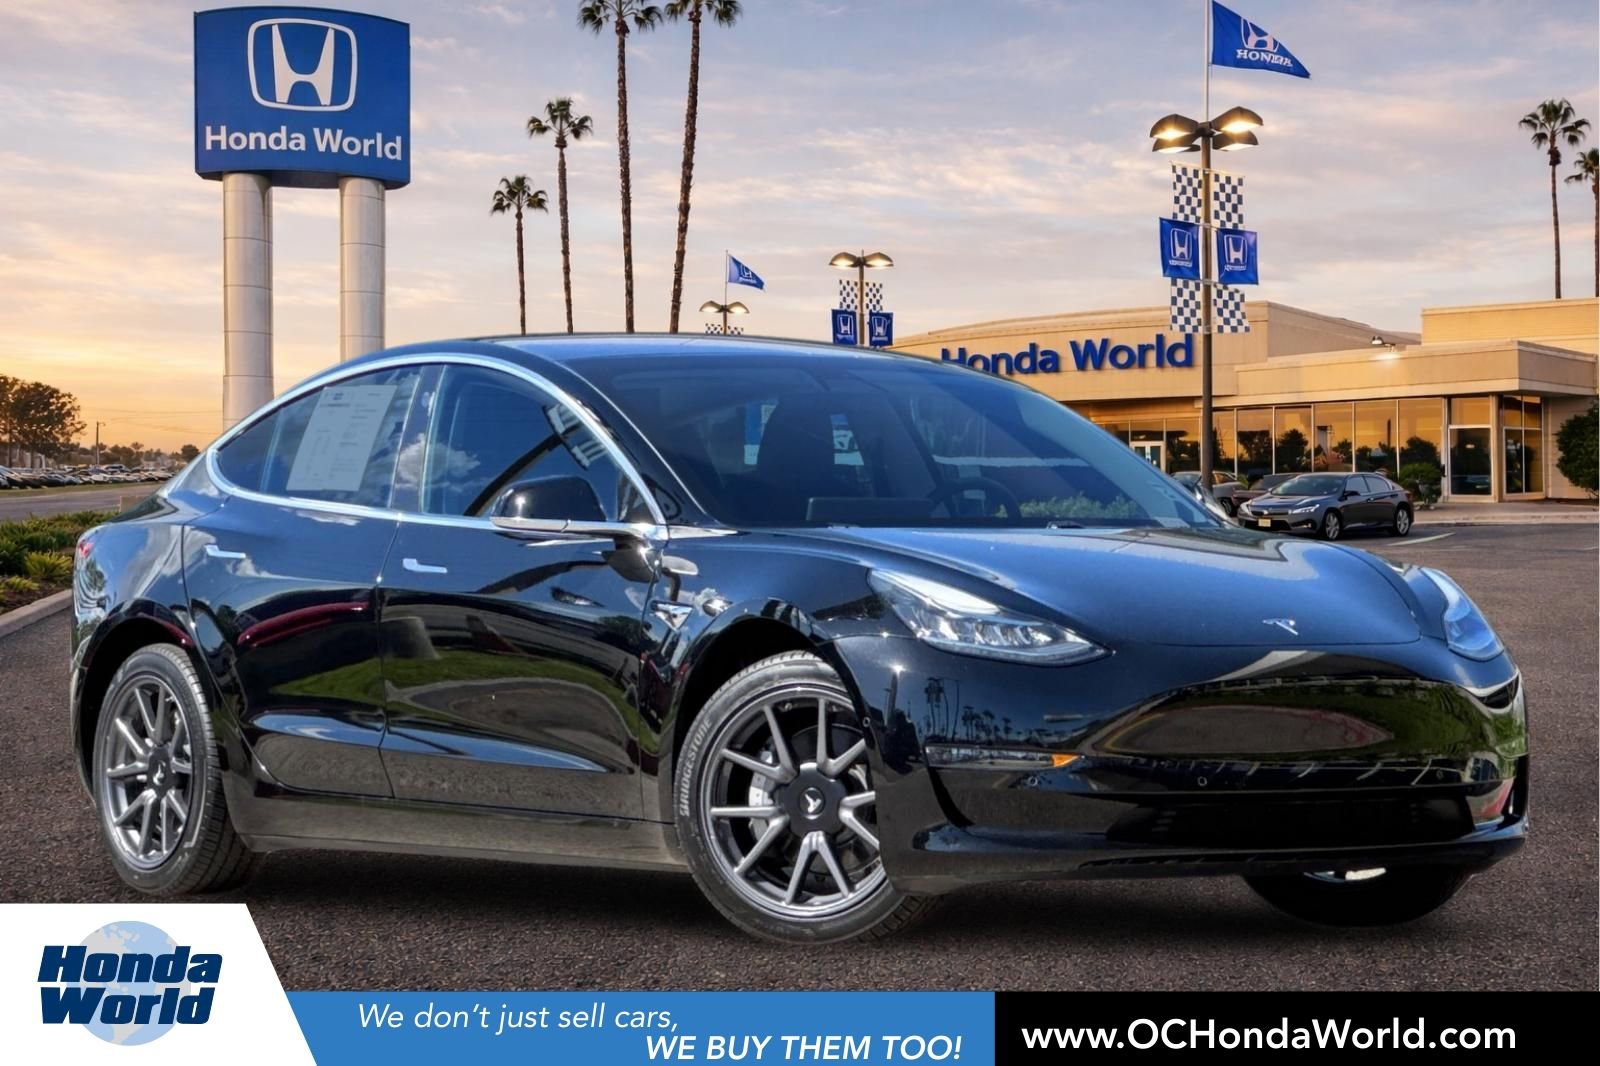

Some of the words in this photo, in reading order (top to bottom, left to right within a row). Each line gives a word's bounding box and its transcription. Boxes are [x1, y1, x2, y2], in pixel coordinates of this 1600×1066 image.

[205, 125, 306, 151] Honda
[313, 127, 402, 160] World
[1070, 333, 1194, 371] World
[680, 718, 712, 816] BRIDGESTONE
